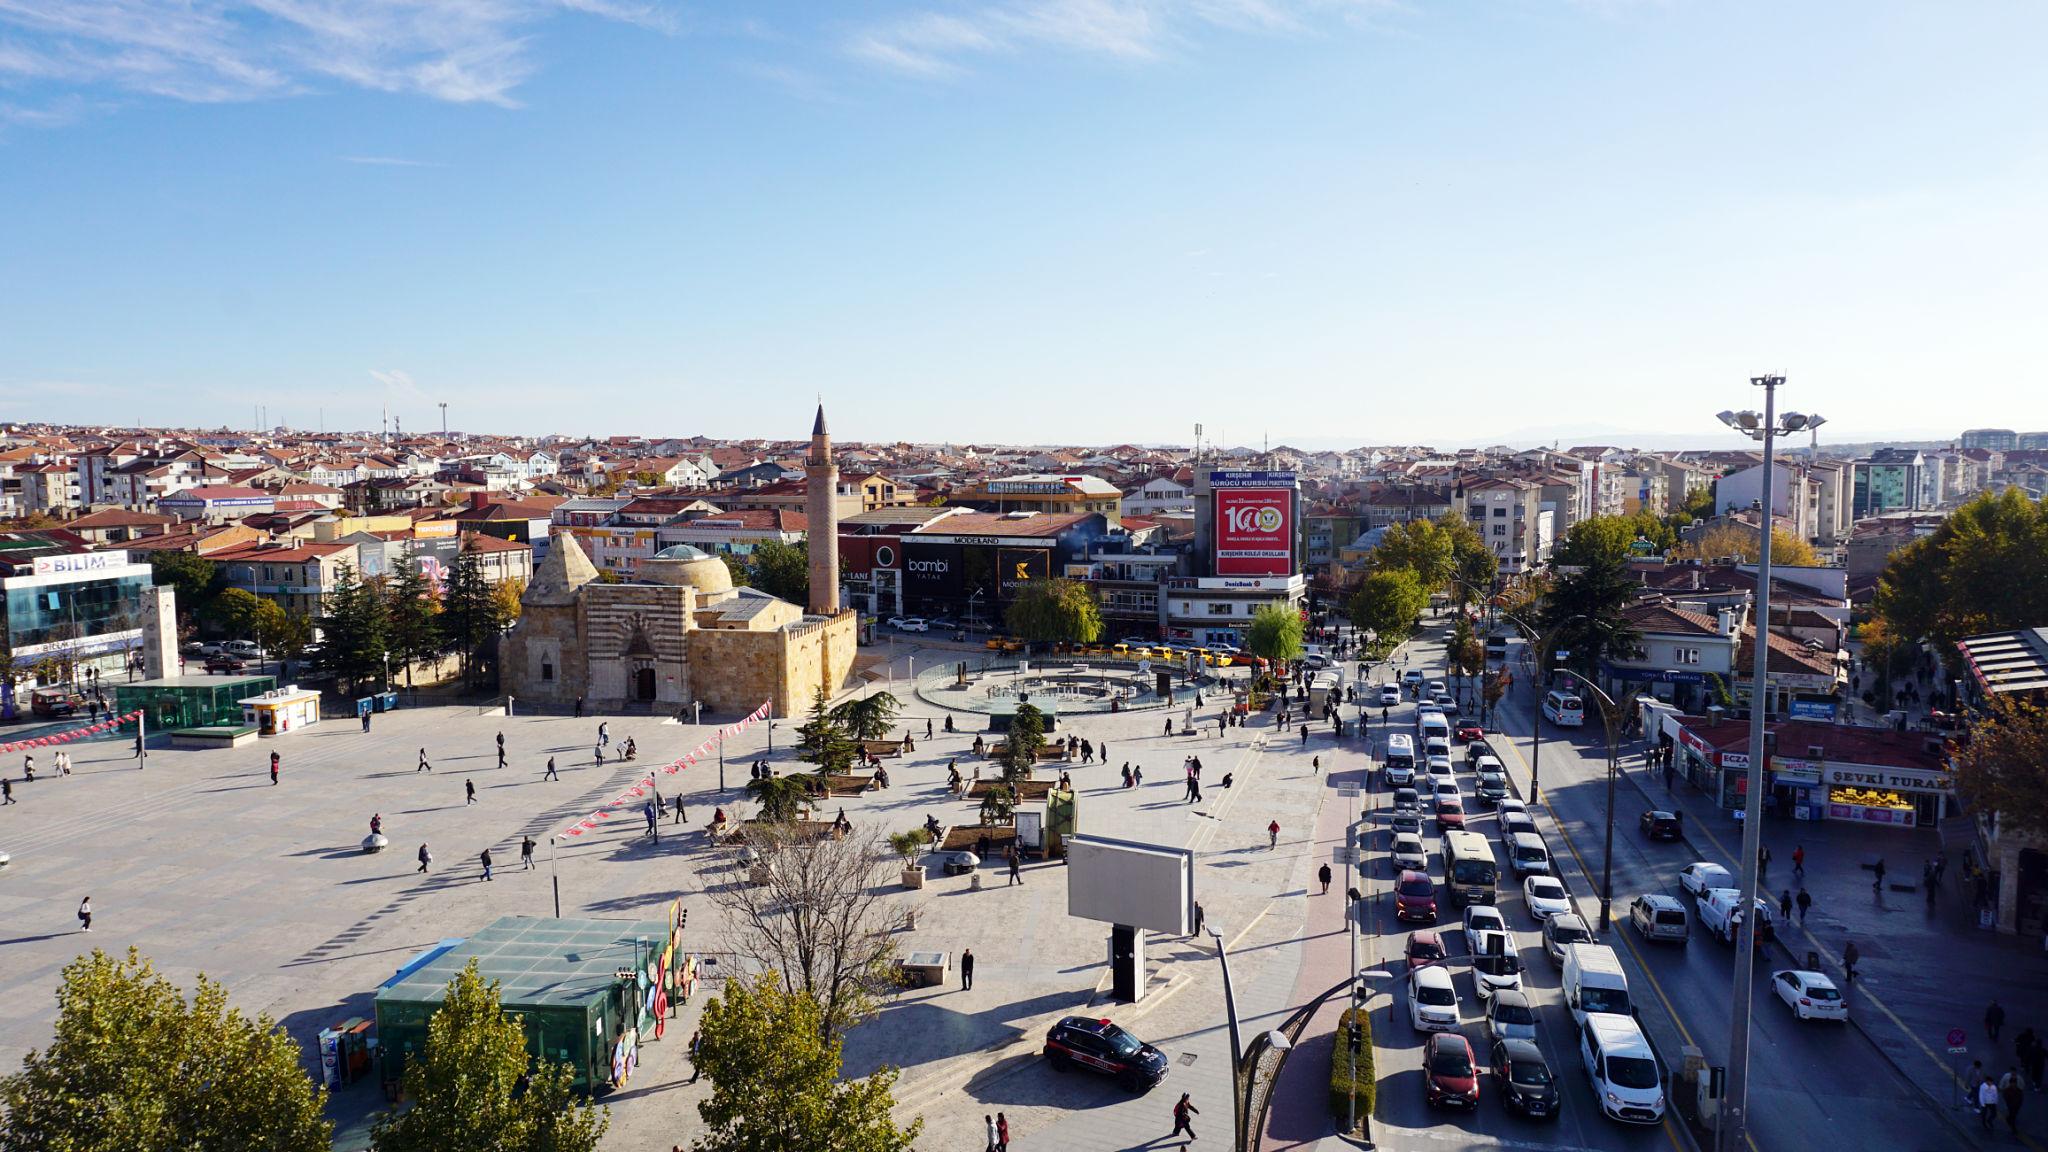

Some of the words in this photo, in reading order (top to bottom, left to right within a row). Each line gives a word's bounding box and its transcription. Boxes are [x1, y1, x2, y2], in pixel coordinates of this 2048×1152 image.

[54, 555, 106, 572] BİLİM
[908, 558, 949, 573] bambi
[1833, 771, 1885, 784] ŞEVKİ
